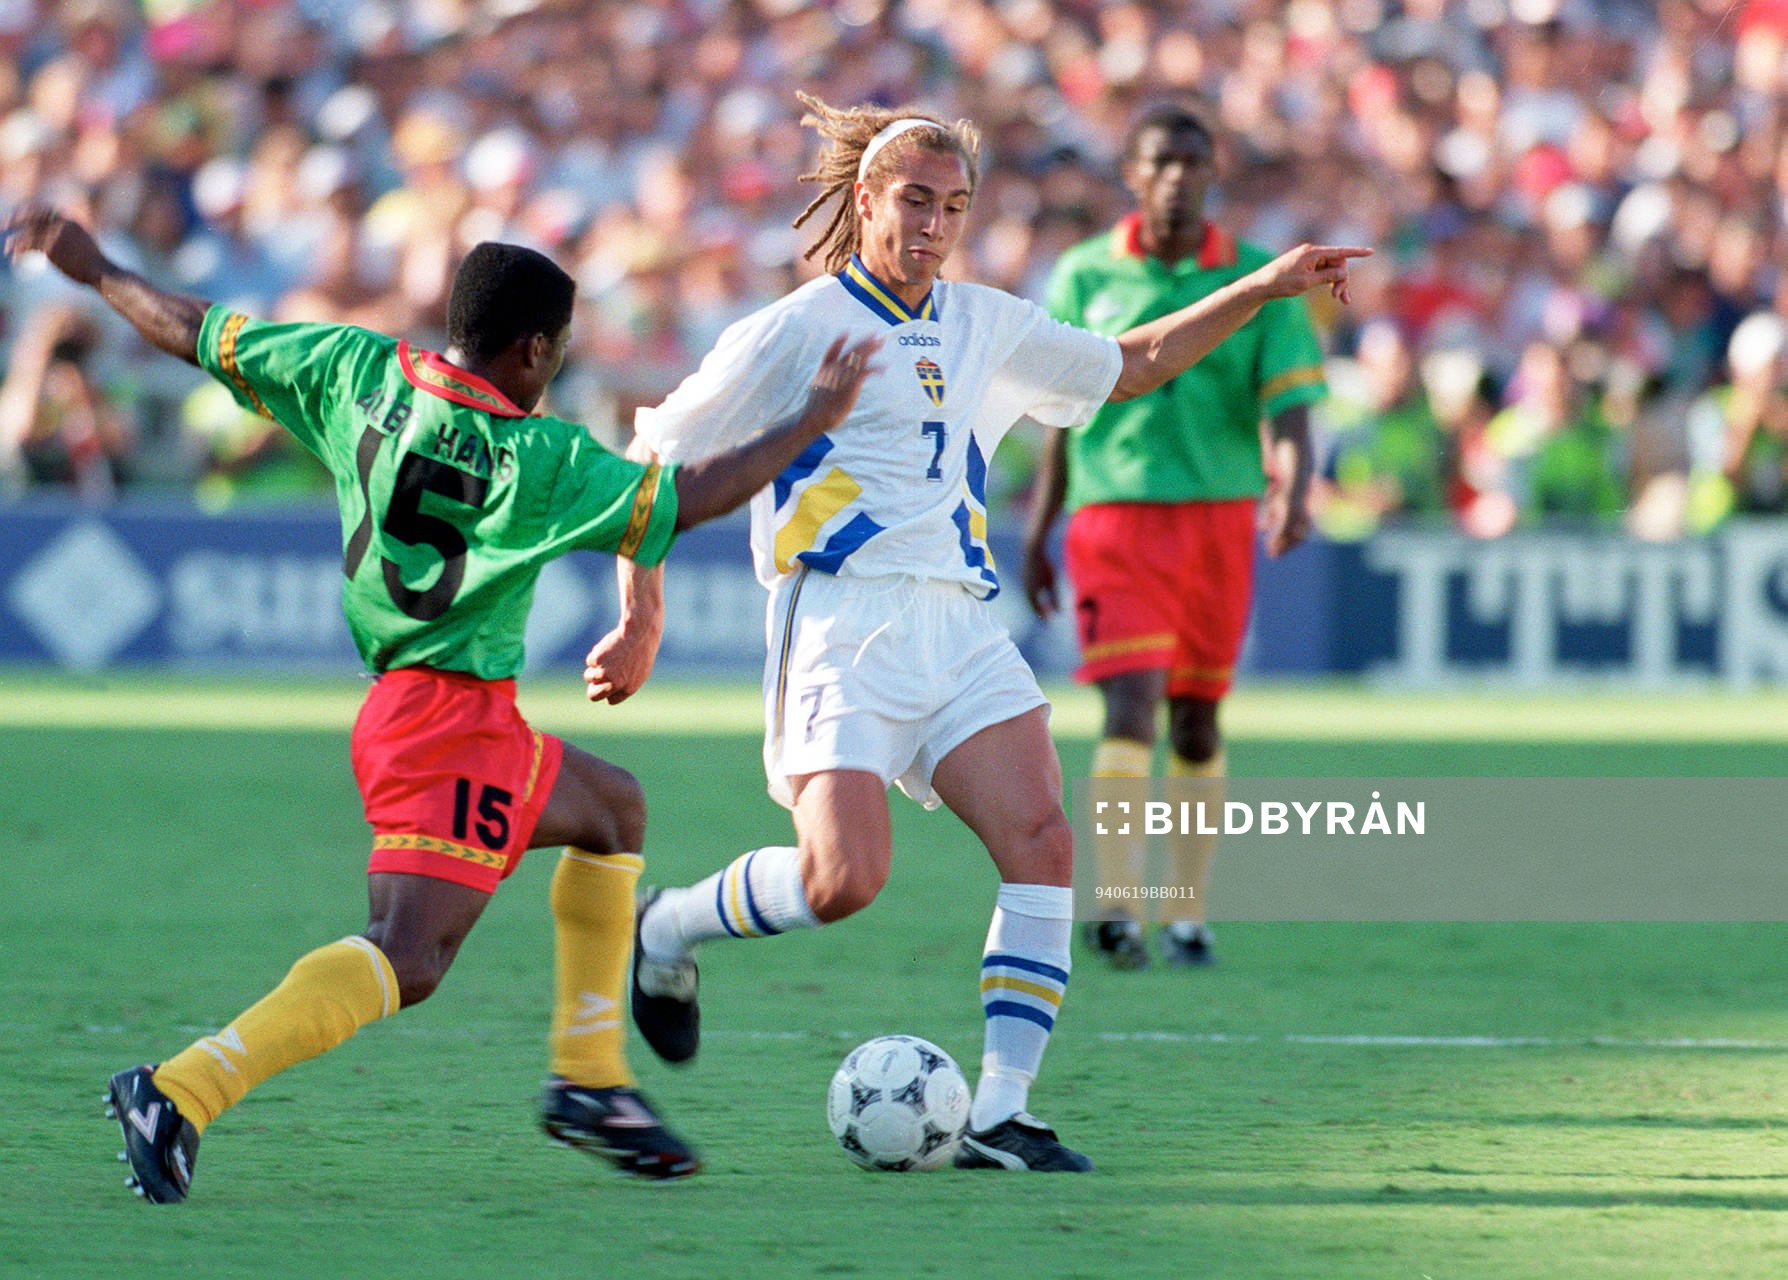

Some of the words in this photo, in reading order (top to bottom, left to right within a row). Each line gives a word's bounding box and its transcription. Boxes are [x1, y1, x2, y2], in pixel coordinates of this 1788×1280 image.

[899, 332, 942, 347] adidas
[921, 421, 946, 483] 7
[346, 424, 490, 622] 15
[800, 684, 826, 743] 7
[453, 777, 512, 850] 15
